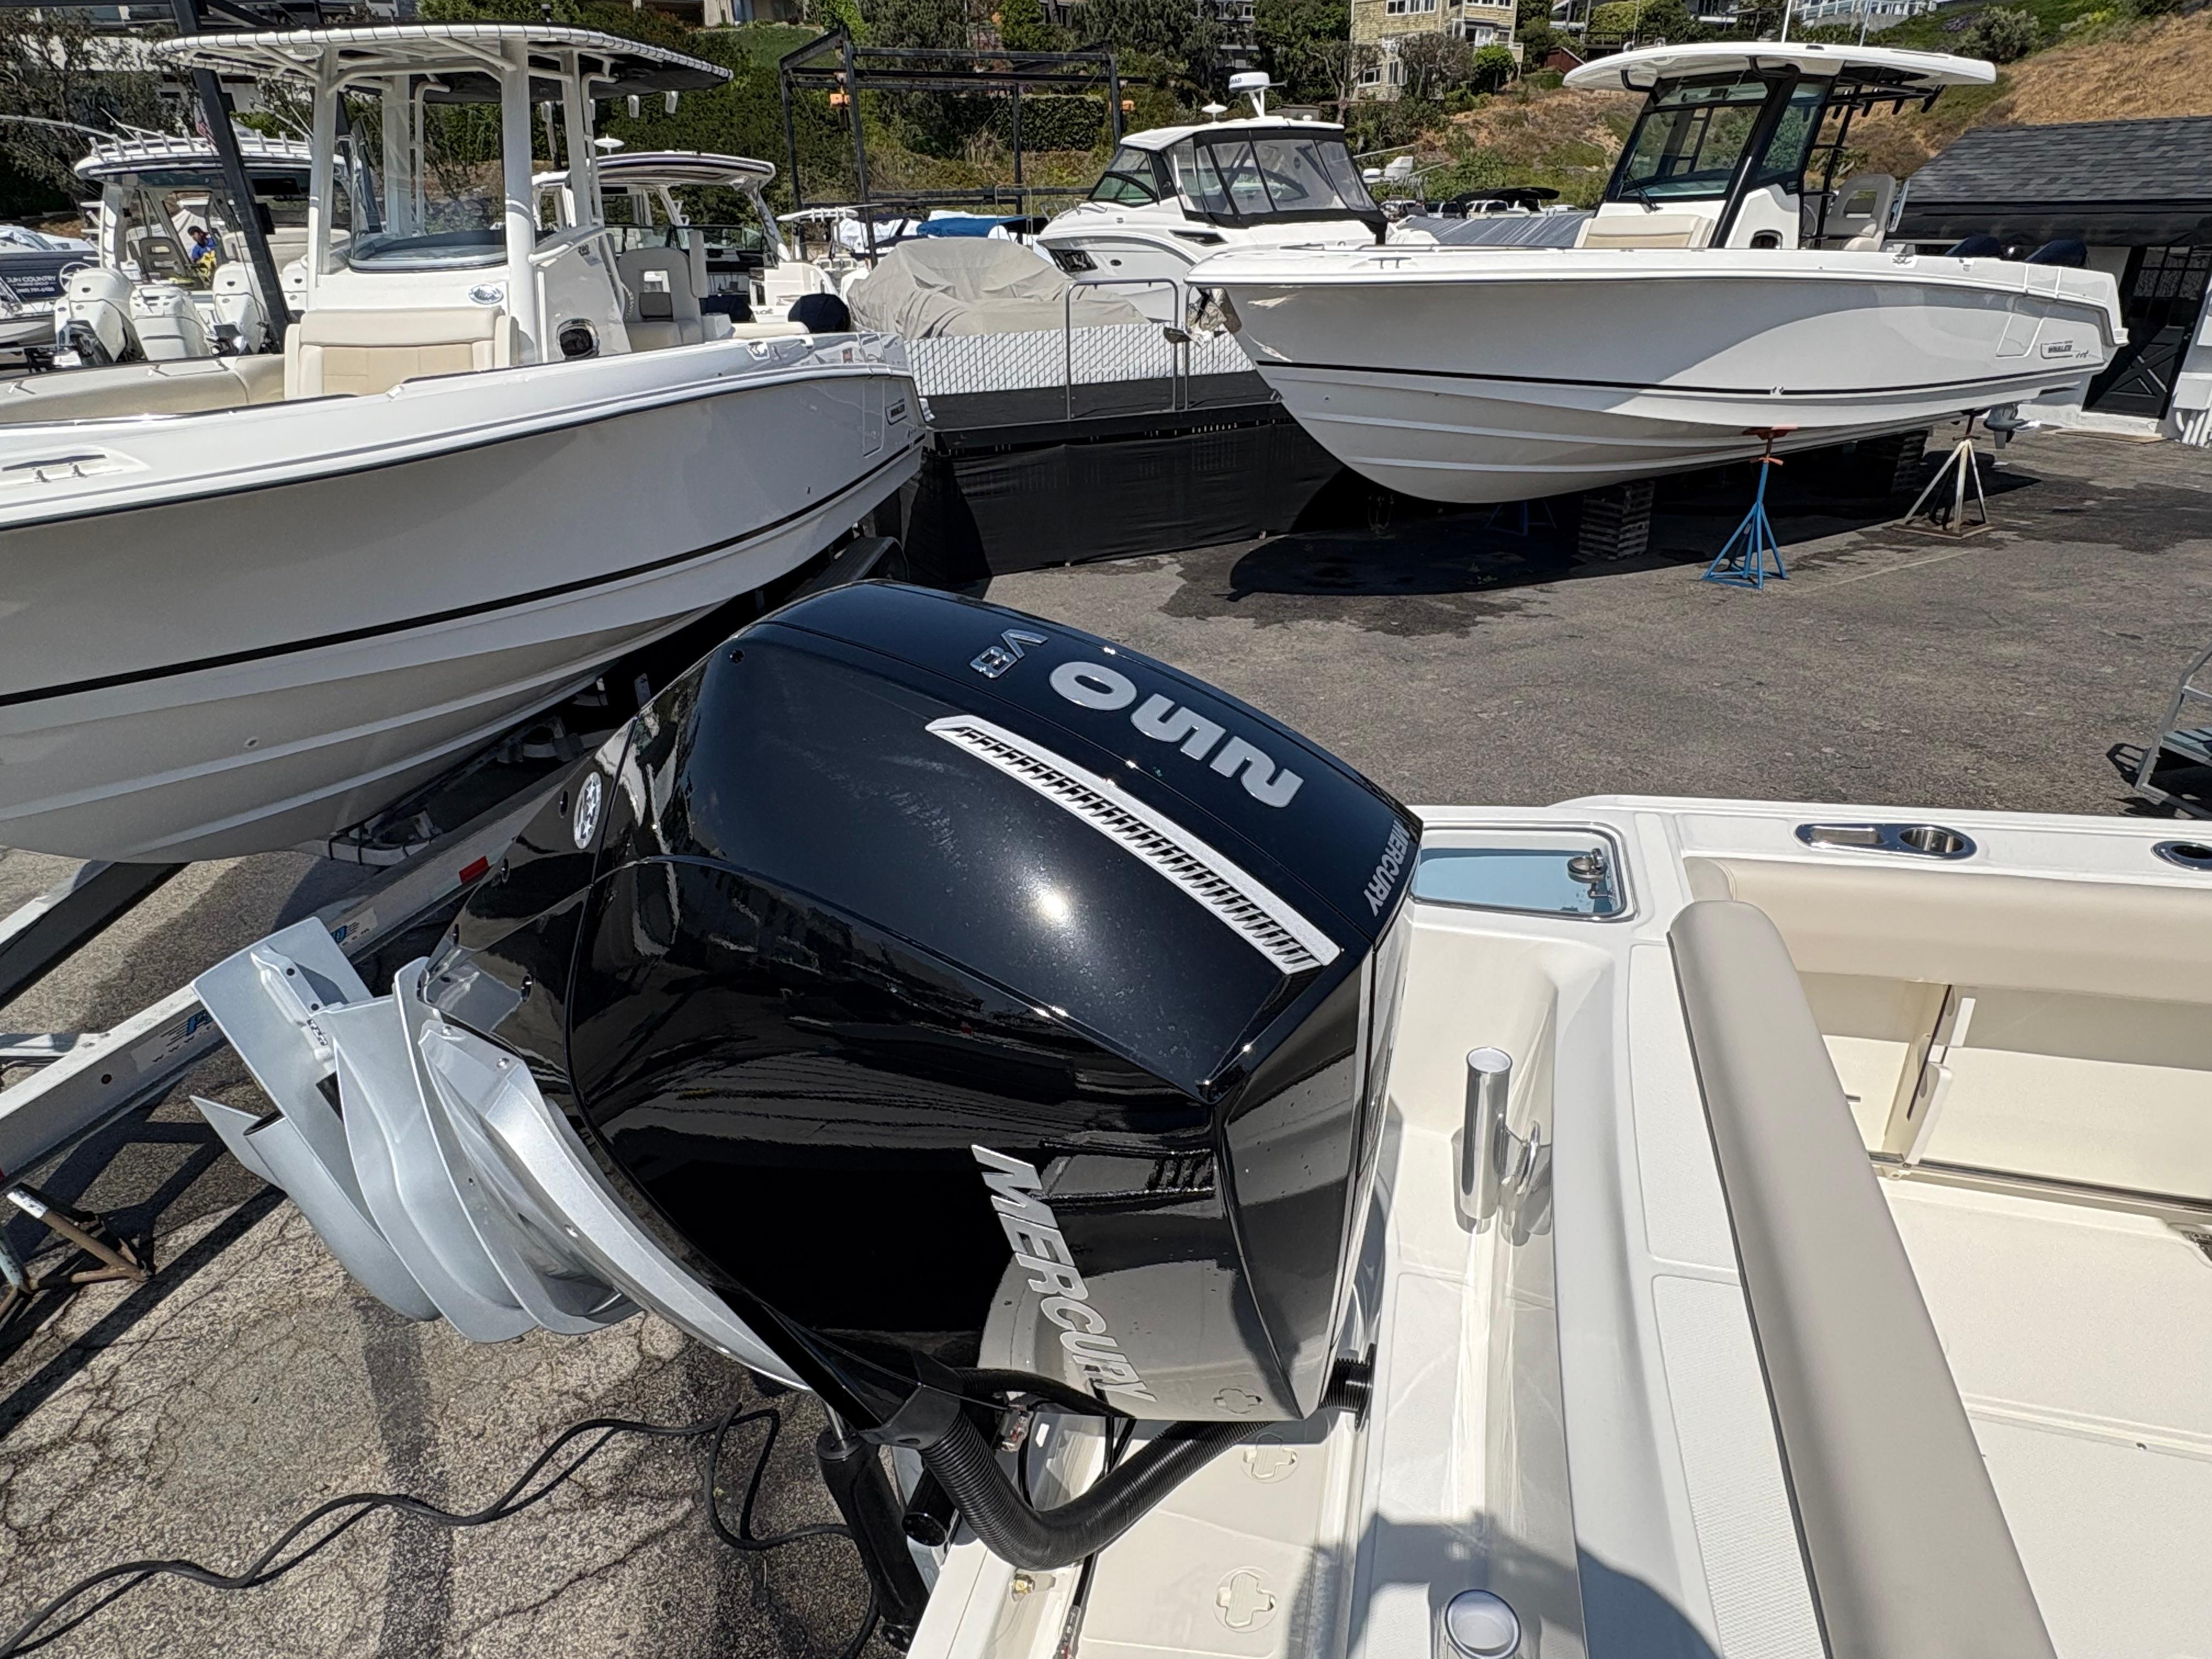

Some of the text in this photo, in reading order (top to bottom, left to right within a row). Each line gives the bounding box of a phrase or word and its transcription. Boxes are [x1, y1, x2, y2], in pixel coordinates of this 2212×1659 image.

[969, 629, 1048, 680] V8
[1363, 817, 1411, 918] MERCURY
[971, 1145, 1158, 1402] MERCURY
